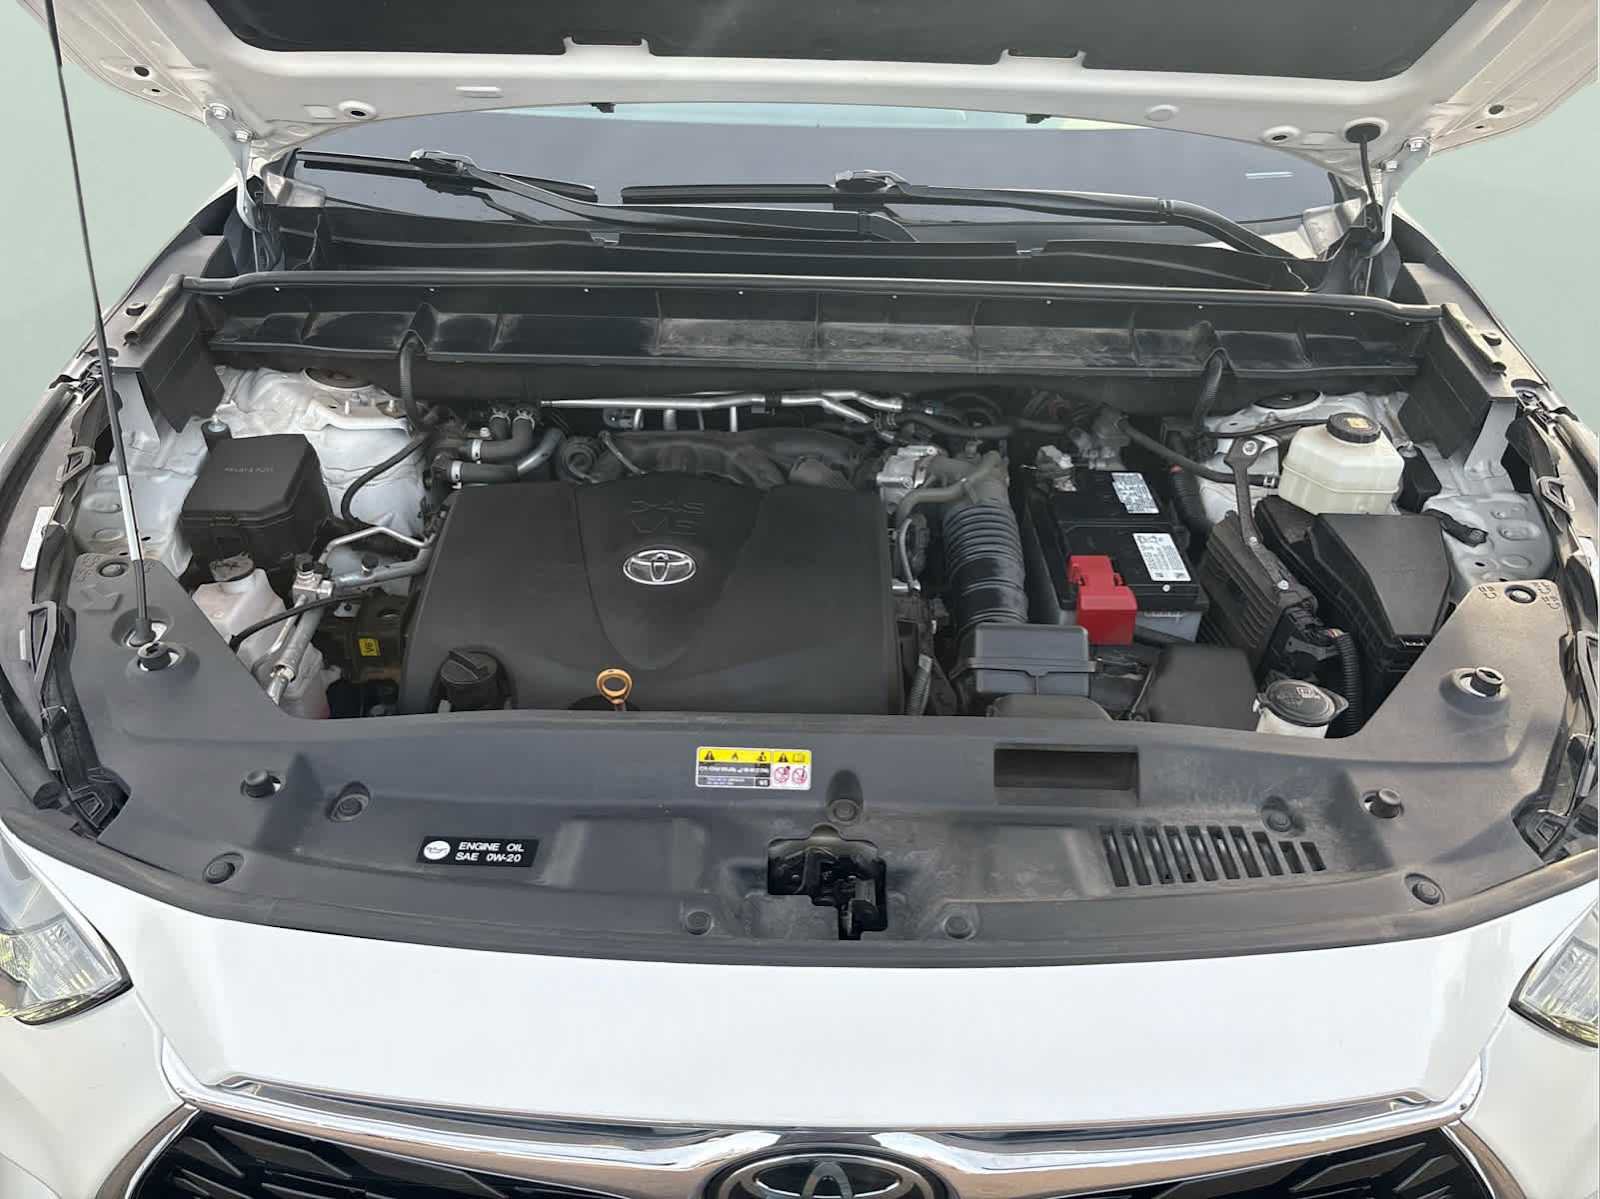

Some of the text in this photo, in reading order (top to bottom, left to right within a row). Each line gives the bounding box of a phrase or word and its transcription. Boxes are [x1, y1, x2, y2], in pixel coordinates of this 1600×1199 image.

[458, 841, 525, 852] ENGINE OIL
[455, 852, 522, 863] SAE 0W-20
